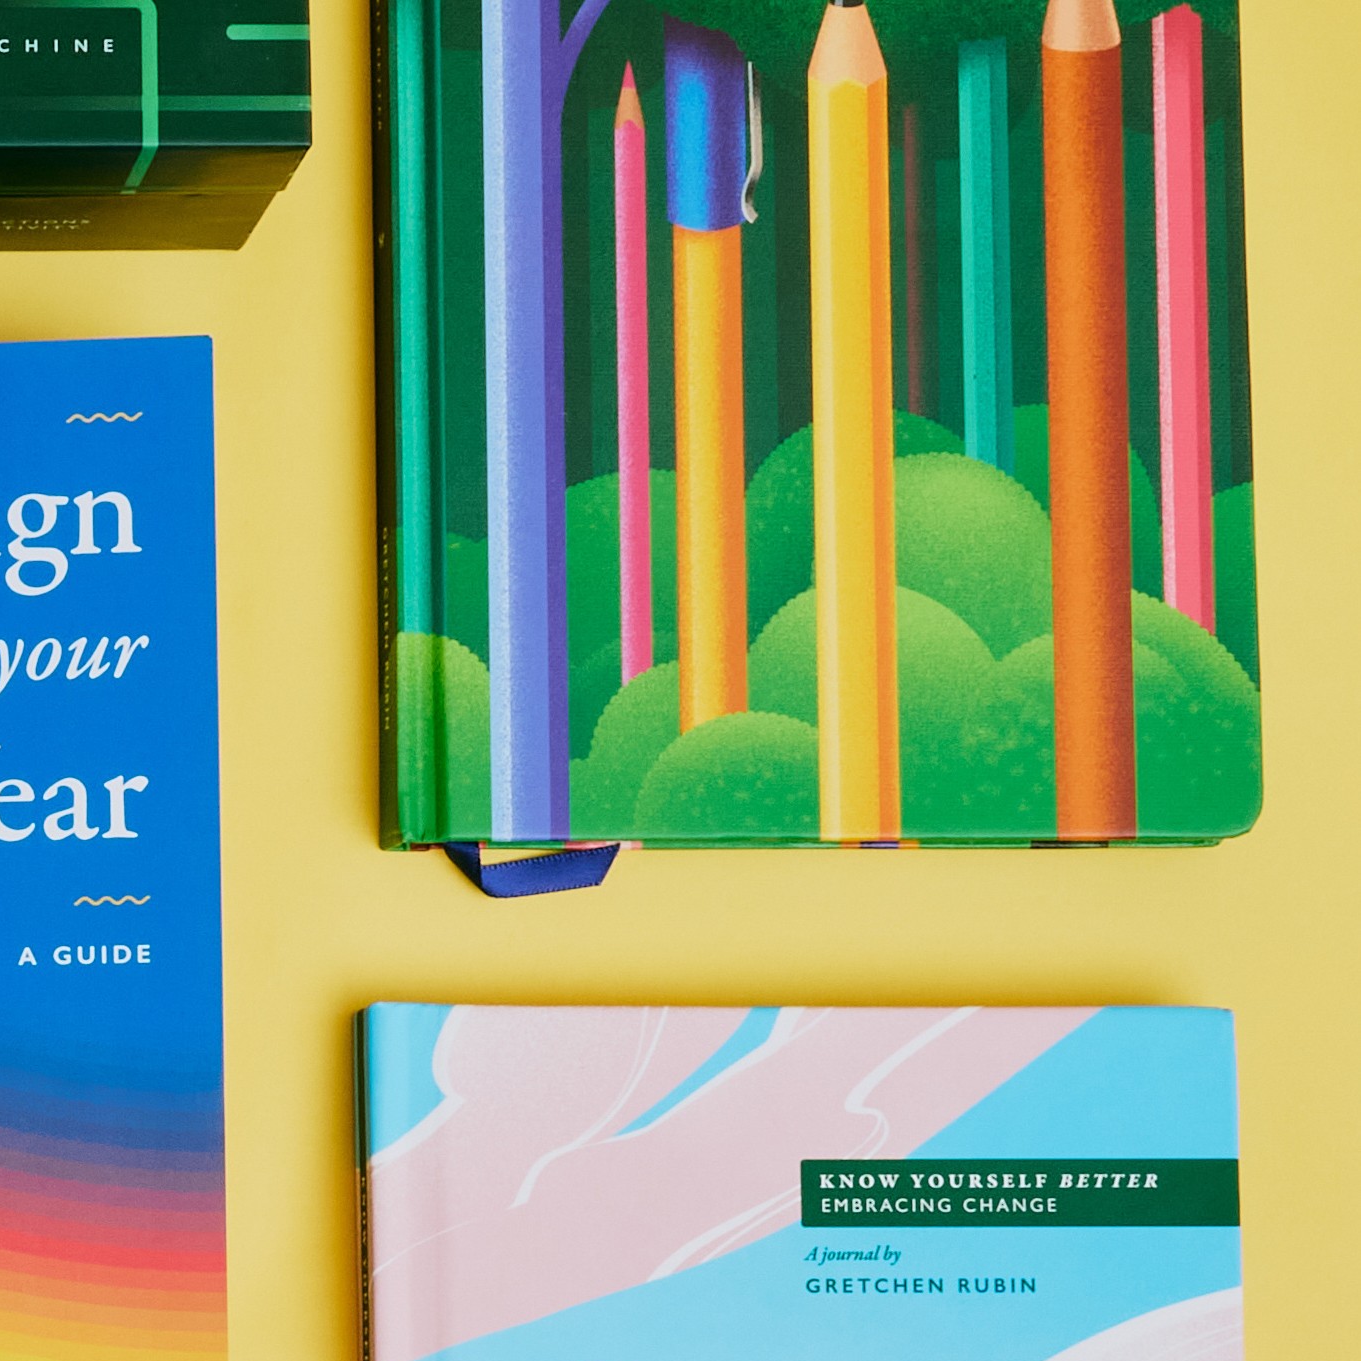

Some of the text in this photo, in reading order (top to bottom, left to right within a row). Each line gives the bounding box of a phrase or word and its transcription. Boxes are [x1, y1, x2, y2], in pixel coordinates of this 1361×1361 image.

[18, 945, 150, 965] A GUIDE
[820, 1174, 1157, 1188] KNOW YOURSELF BETTER
[822, 1198, 1056, 1213] EMBRACING CHANGE
[804, 1245, 901, 1266] A journal by
[806, 1278, 1035, 1293] GRETCHEN RUBIN
